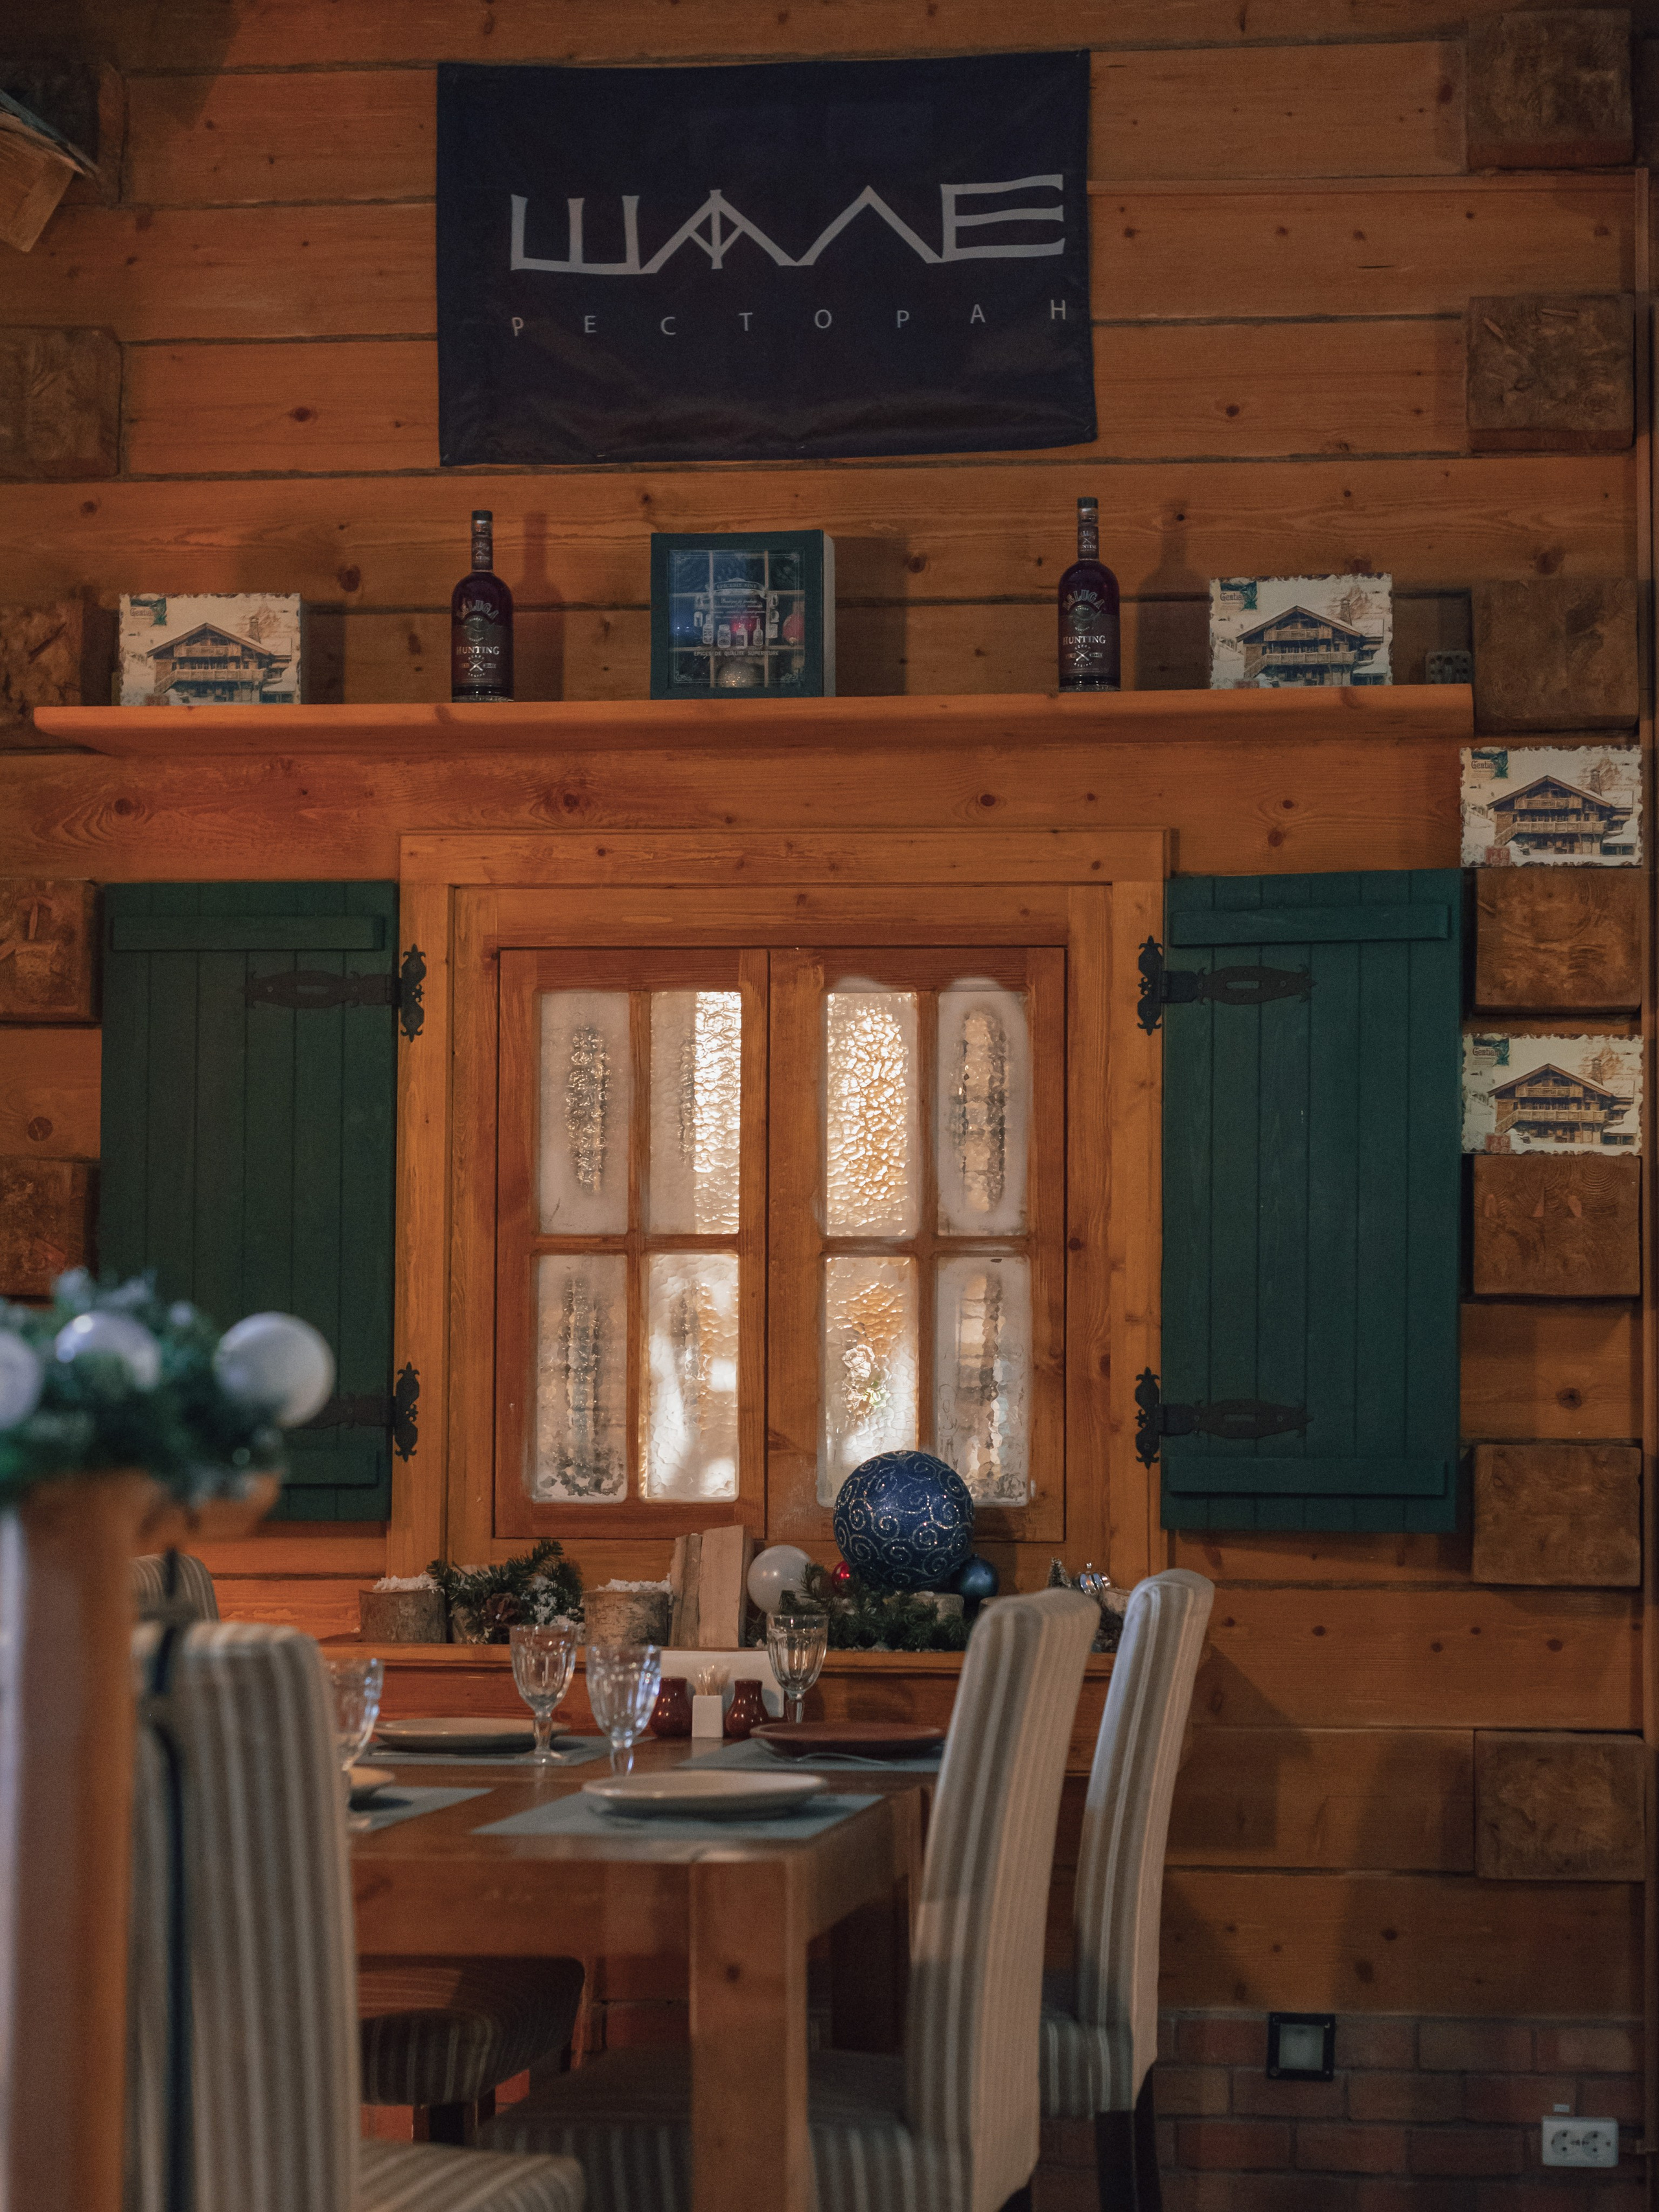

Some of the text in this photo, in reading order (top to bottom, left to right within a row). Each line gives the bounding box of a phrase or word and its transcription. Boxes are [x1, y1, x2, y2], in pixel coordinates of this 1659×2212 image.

[511, 299, 1067, 336] РЕСТОРАН
[1063, 634, 1106, 646] HUNTING
[456, 646, 500, 655] HUNTING
